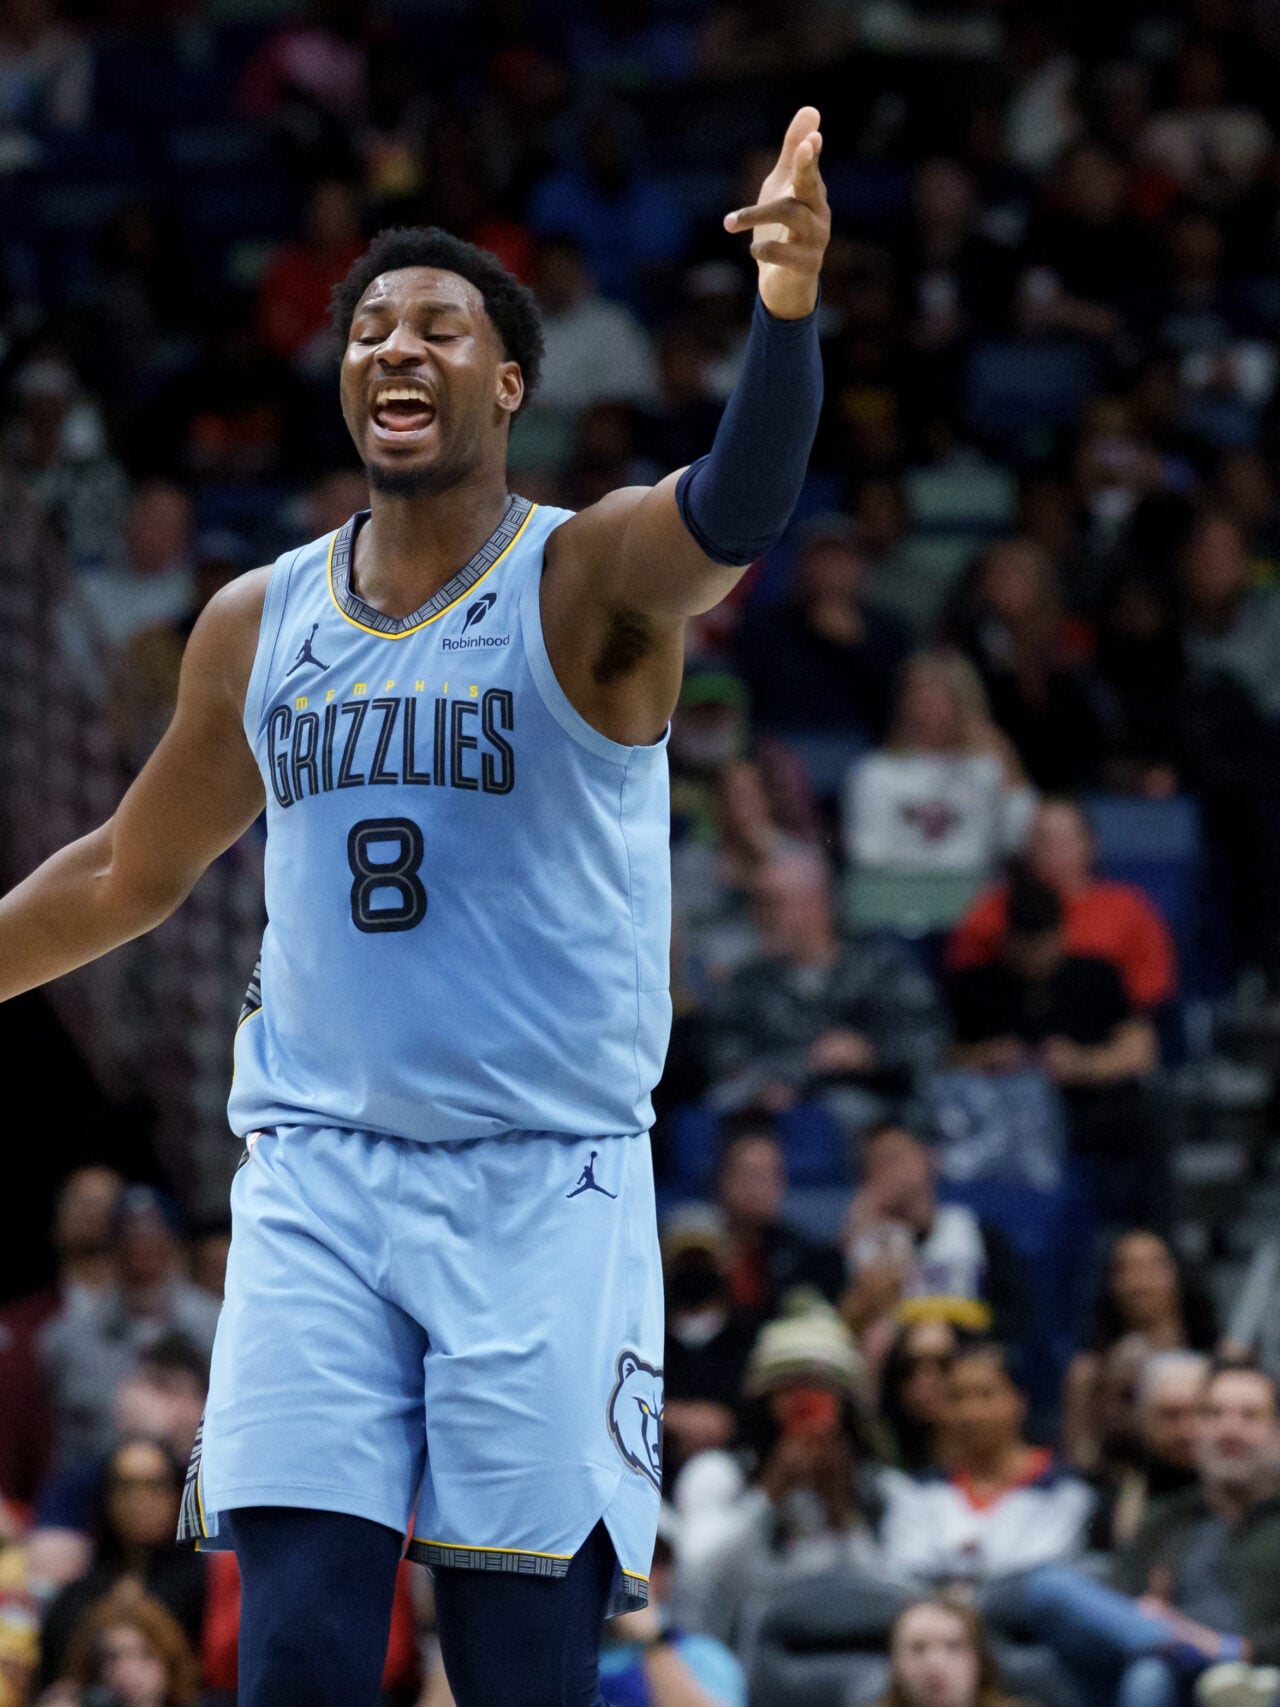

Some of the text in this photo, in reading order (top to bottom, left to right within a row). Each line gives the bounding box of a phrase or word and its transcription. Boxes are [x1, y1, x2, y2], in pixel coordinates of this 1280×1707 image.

[442, 634, 510, 651] Robinhood
[295, 680, 479, 711] MEMPHIS
[267, 688, 515, 809] GRIZZLIES
[347, 817, 427, 933] 8
